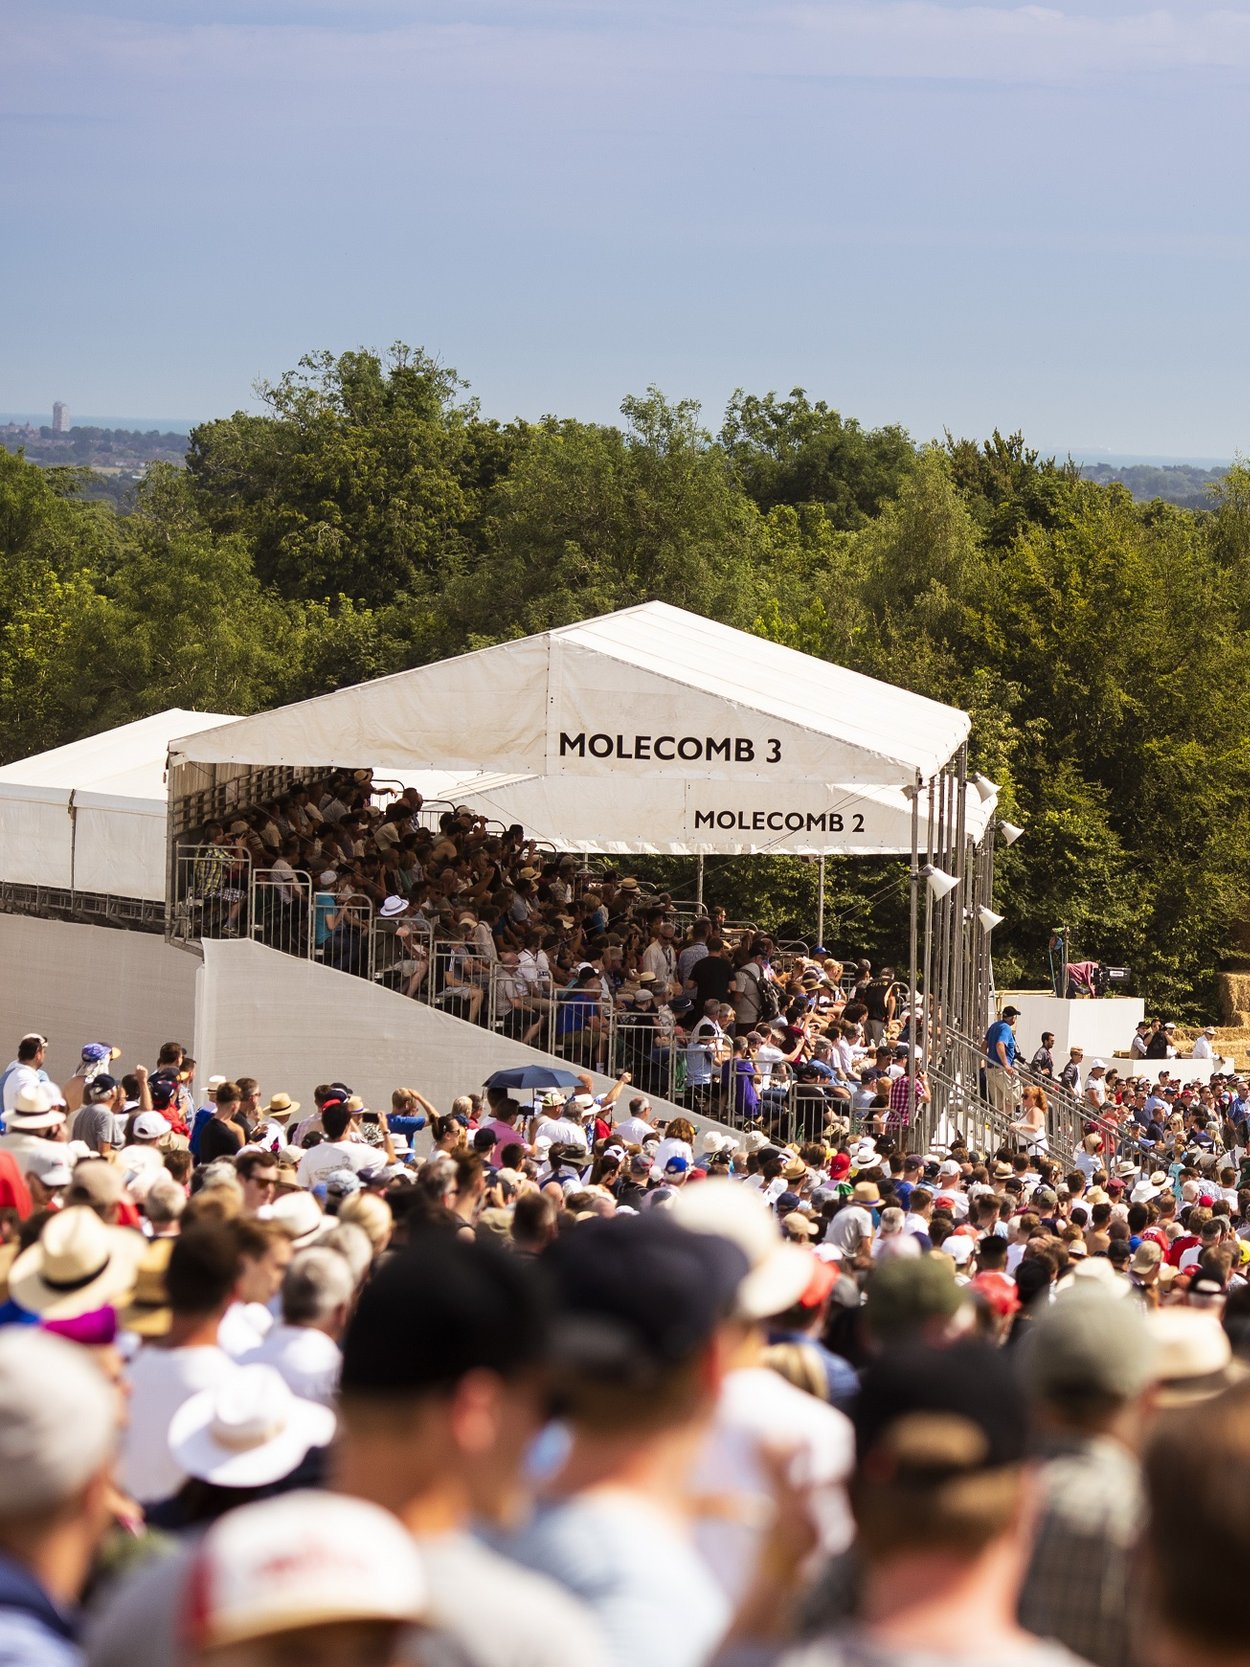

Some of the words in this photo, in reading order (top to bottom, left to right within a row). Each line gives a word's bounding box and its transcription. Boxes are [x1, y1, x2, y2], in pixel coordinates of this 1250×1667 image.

[559, 732, 755, 762] MOLECOMB
[766, 738, 782, 763] 3
[695, 810, 844, 832] MOLECOMB
[852, 813, 865, 833] 2
